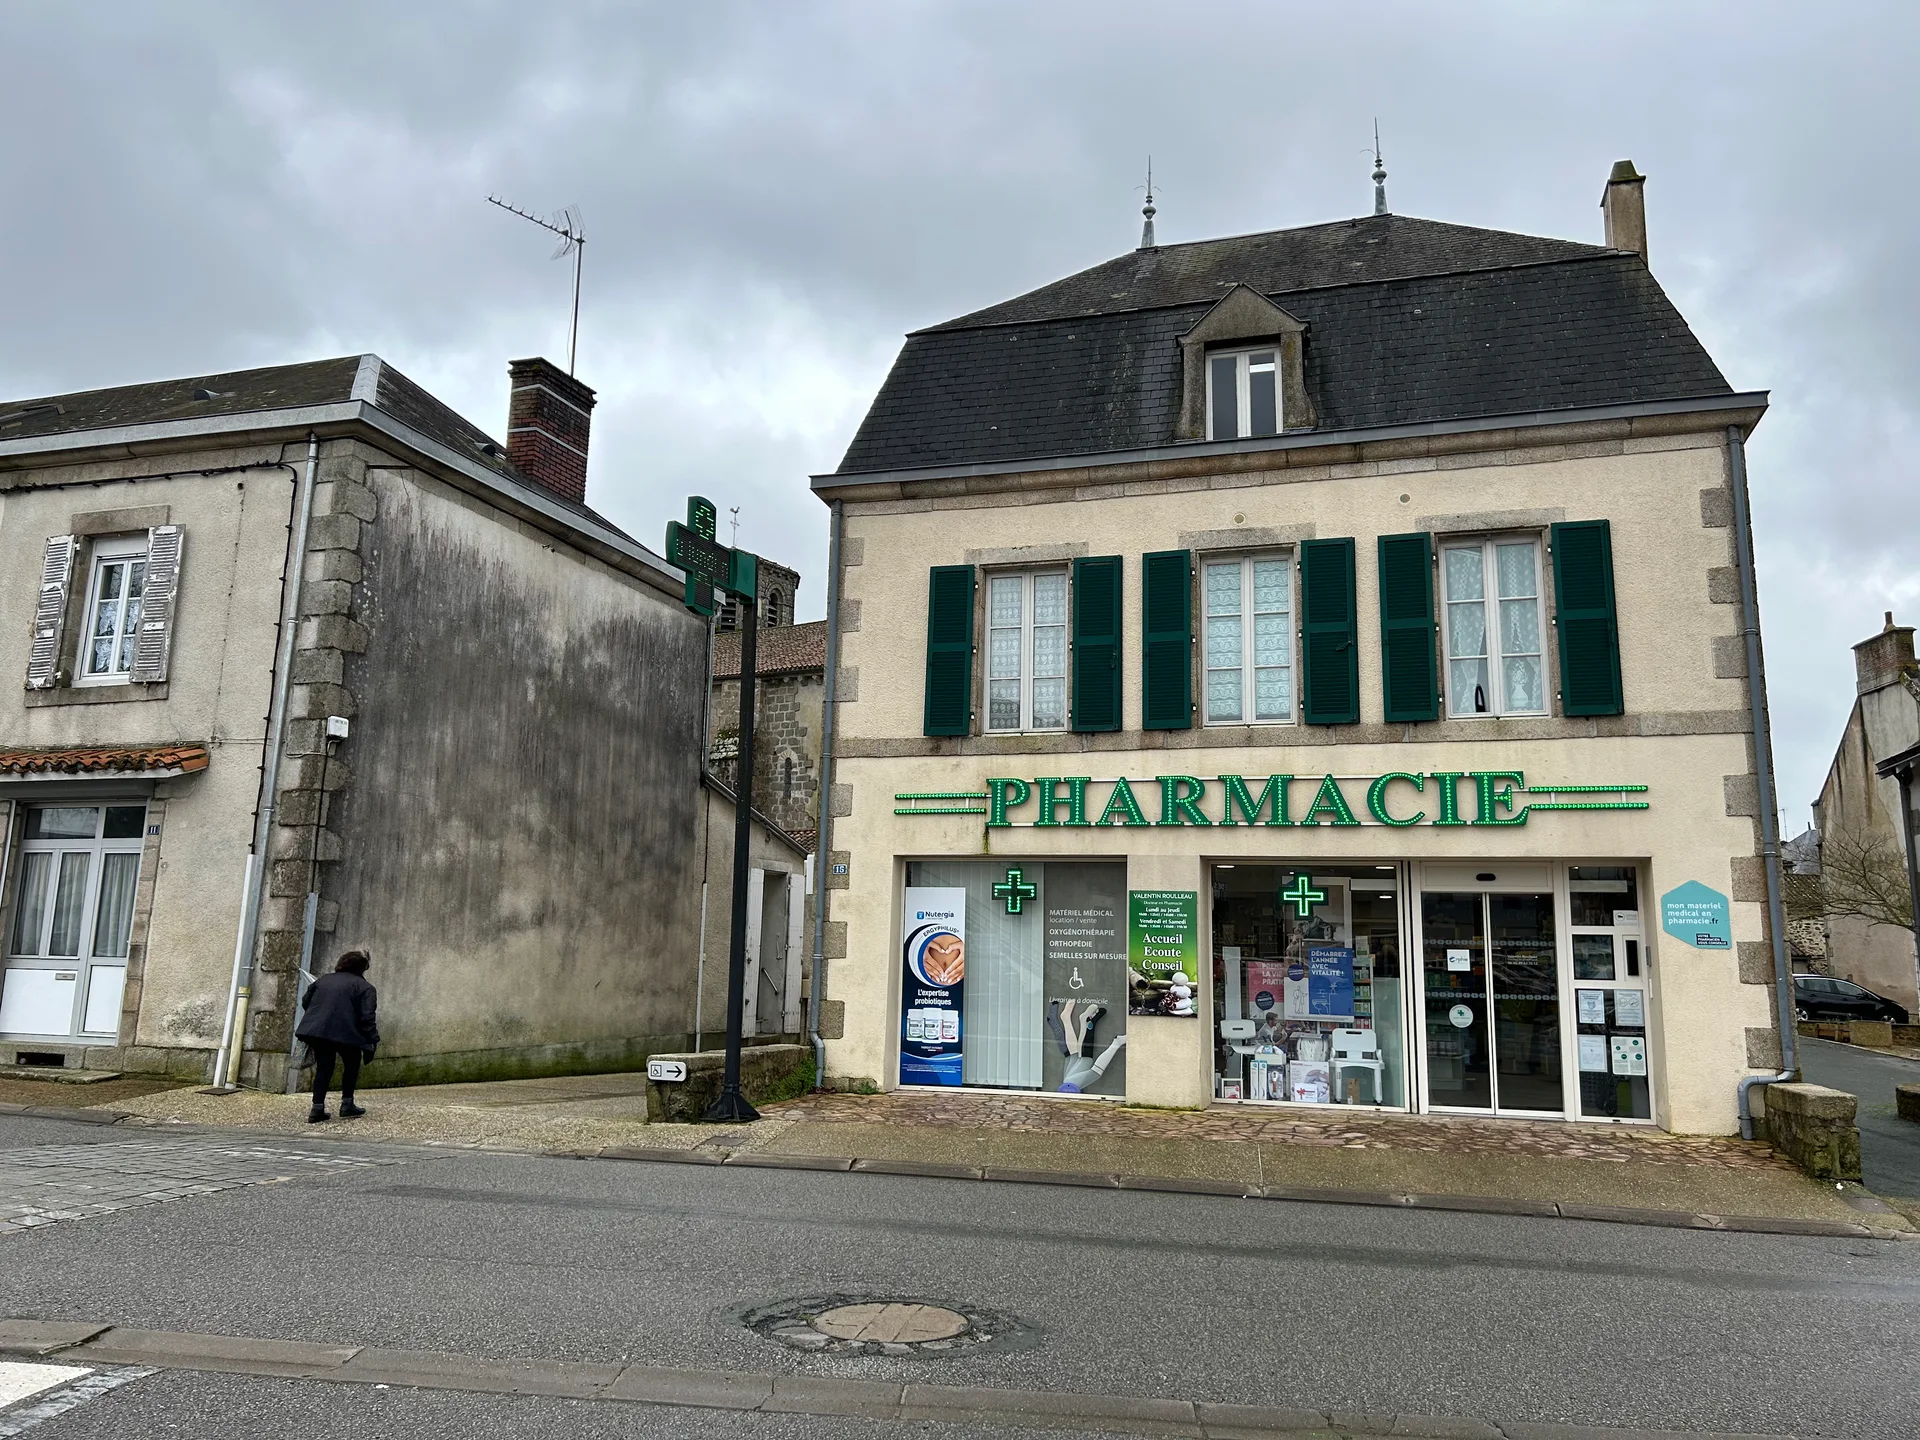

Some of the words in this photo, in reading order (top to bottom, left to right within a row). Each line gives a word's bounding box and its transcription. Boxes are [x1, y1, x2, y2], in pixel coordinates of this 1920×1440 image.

[987, 771, 1530, 827] PHARMACIE
[1142, 933, 1182, 944] Accueil
[1144, 946, 1182, 957] Ecoute
[1142, 959, 1182, 970] Conseil
[918, 988, 950, 997] L'expertise
[915, 998, 952, 1006] probiotiques
